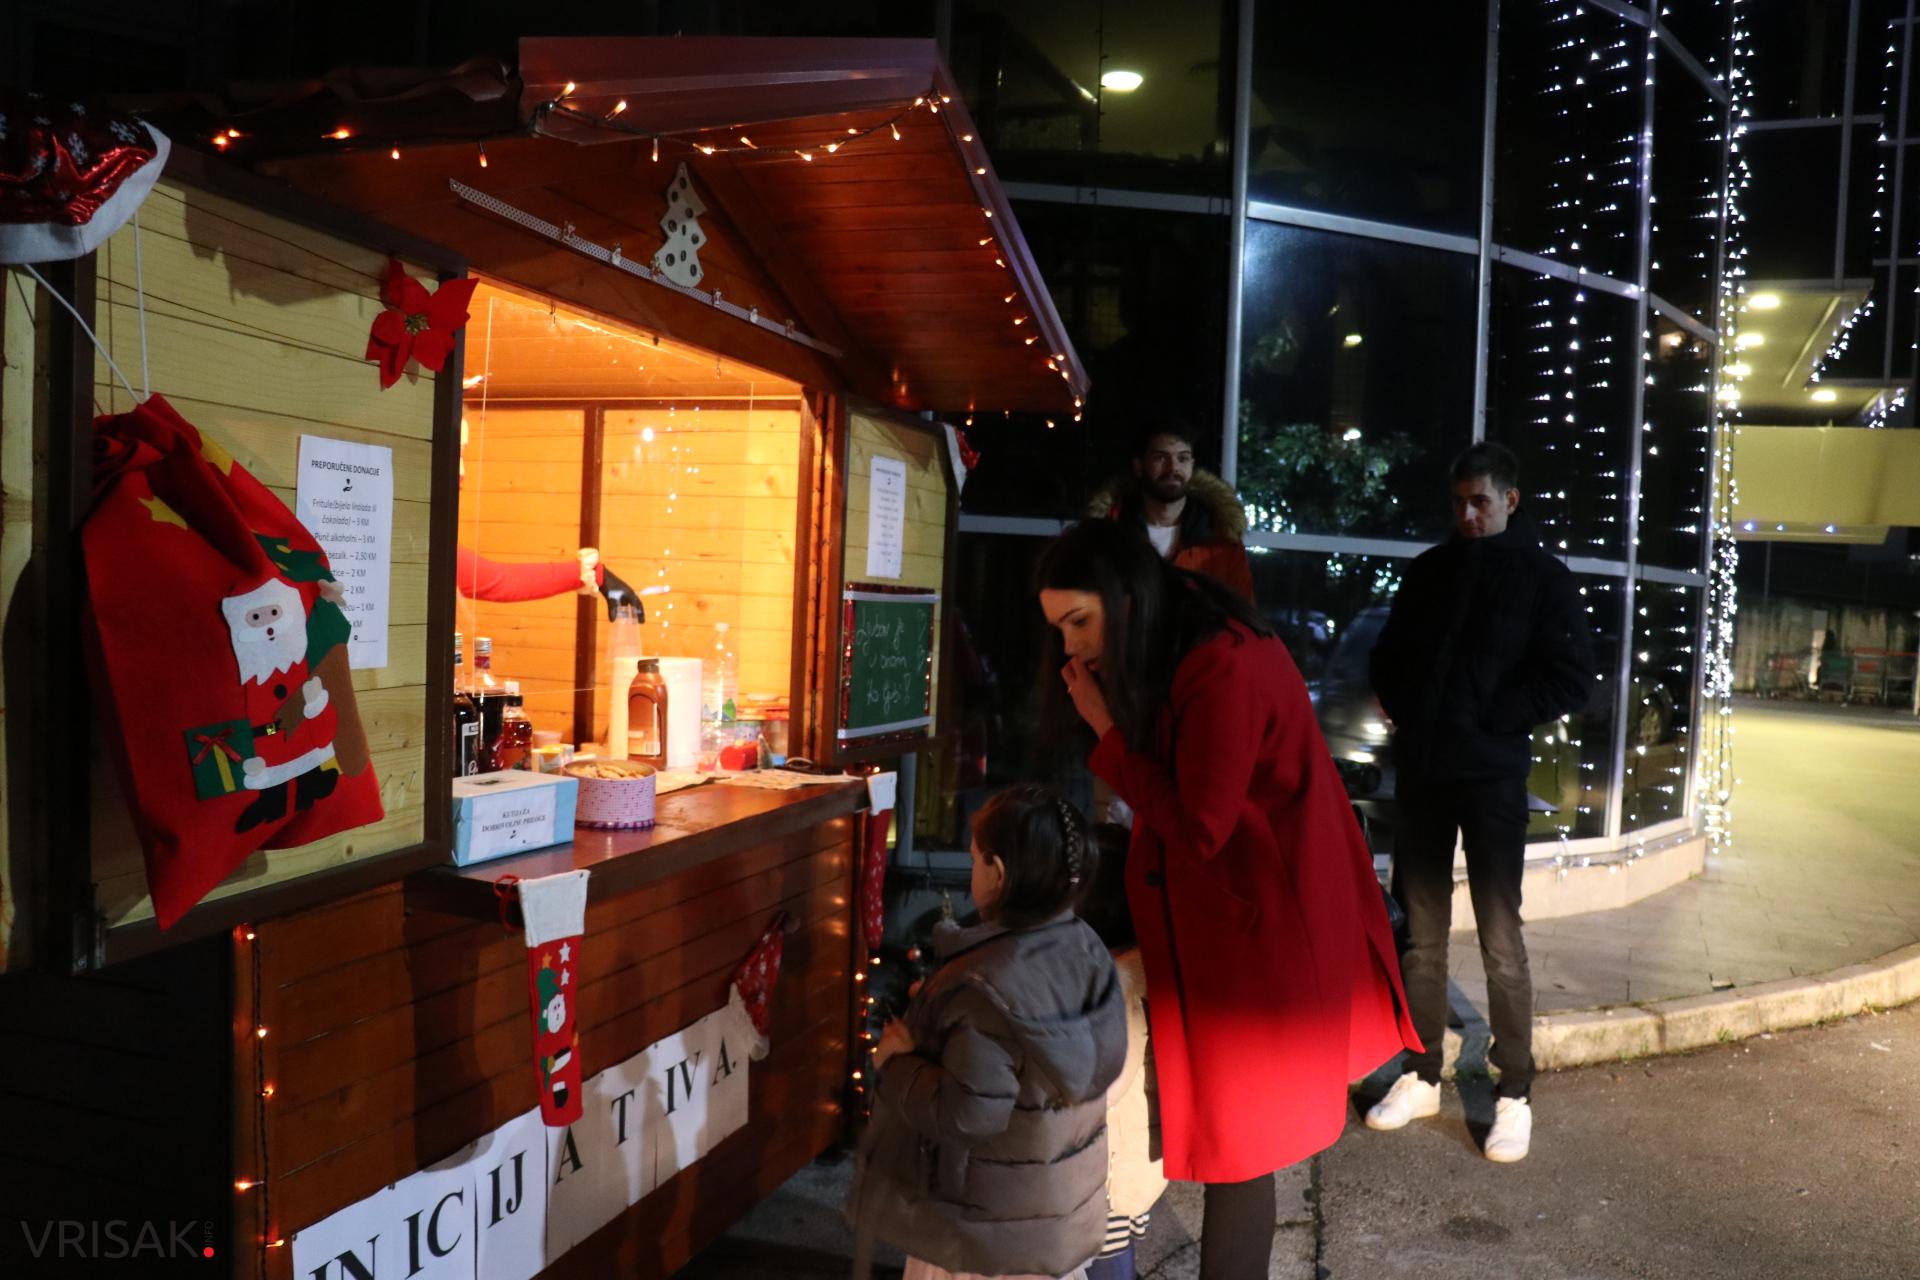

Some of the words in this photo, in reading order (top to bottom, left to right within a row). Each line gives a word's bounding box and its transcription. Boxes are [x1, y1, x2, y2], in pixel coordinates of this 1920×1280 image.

[367, 535, 376, 544] KM
[368, 552, 377, 561] KM
[356, 569, 366, 577] KM
[356, 586, 365, 594] KM
[366, 603, 374, 611] KM
